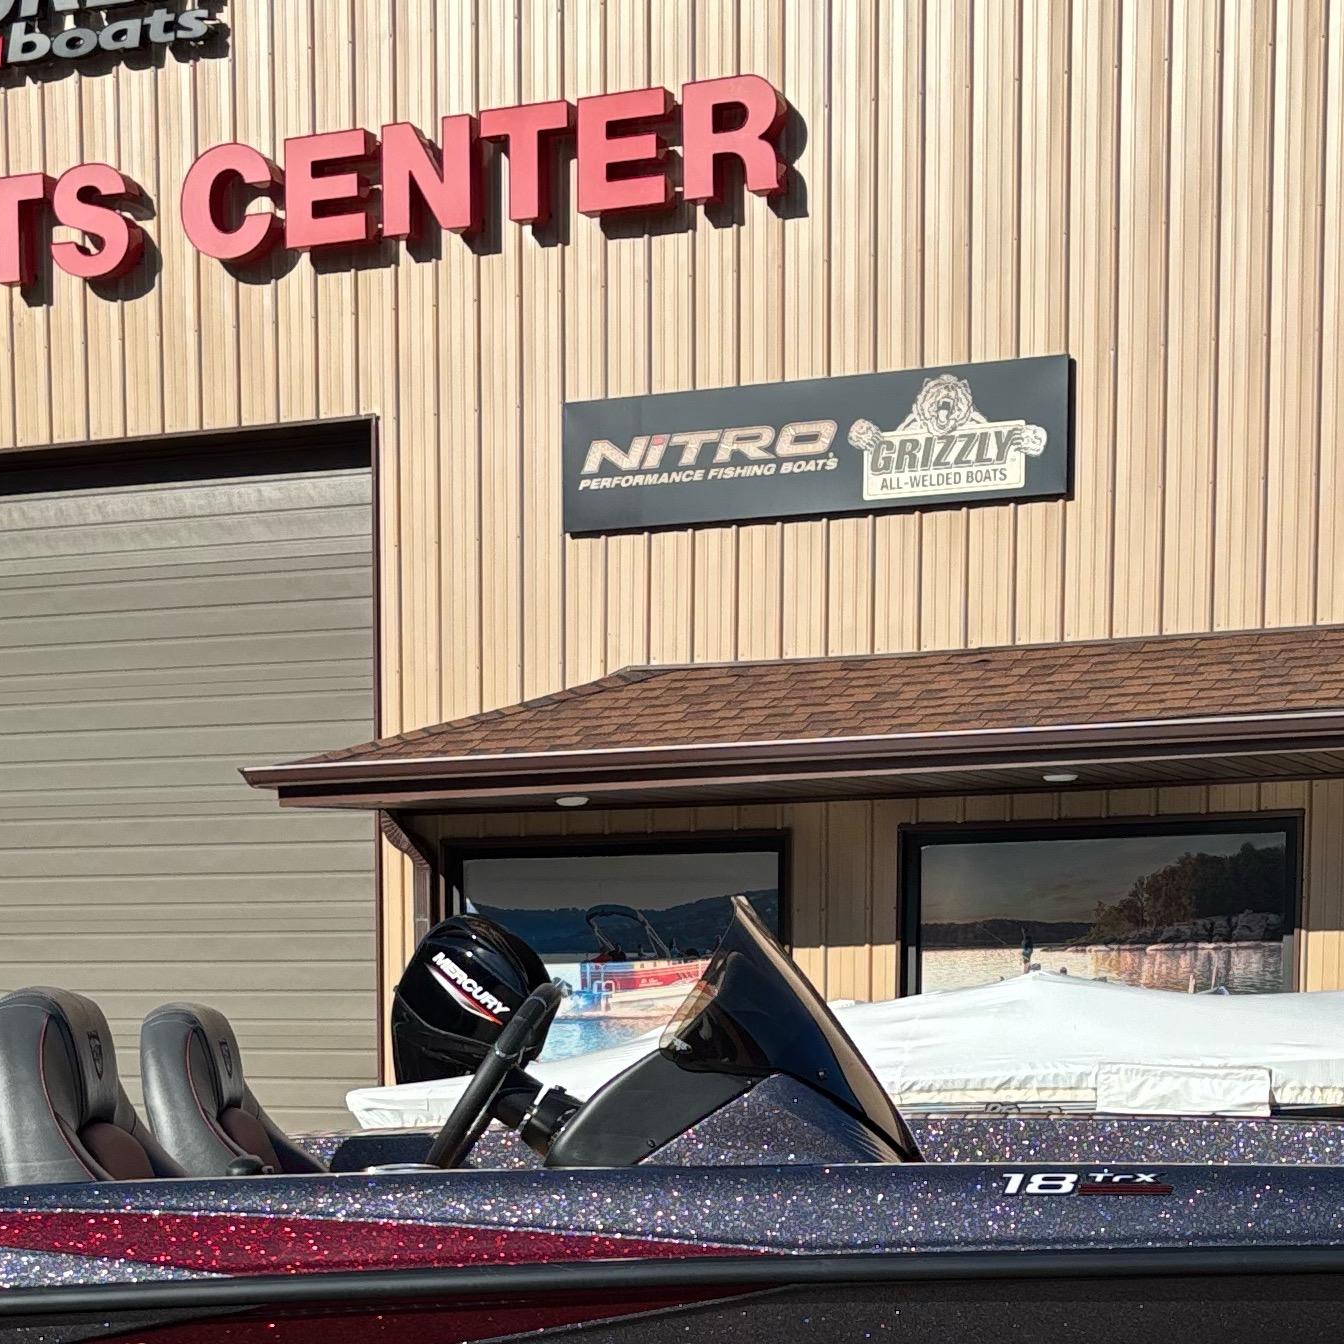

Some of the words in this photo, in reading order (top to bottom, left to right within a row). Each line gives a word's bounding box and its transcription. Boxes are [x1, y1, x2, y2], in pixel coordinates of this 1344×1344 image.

[7, 8, 209, 63] boats
[180, 73, 784, 260] CENTER
[580, 419, 838, 475] NITRO
[870, 429, 1015, 475] GRIZZLY
[578, 469, 705, 491] PERFORMANCE
[707, 463, 776, 480] FISHING
[780, 458, 839, 473] BOATS
[880, 472, 961, 491] ALL-WELDED
[966, 468, 1007, 483] BOATS
[432, 951, 511, 1014] MERCURY
[1002, 1173, 1079, 1194] 18
